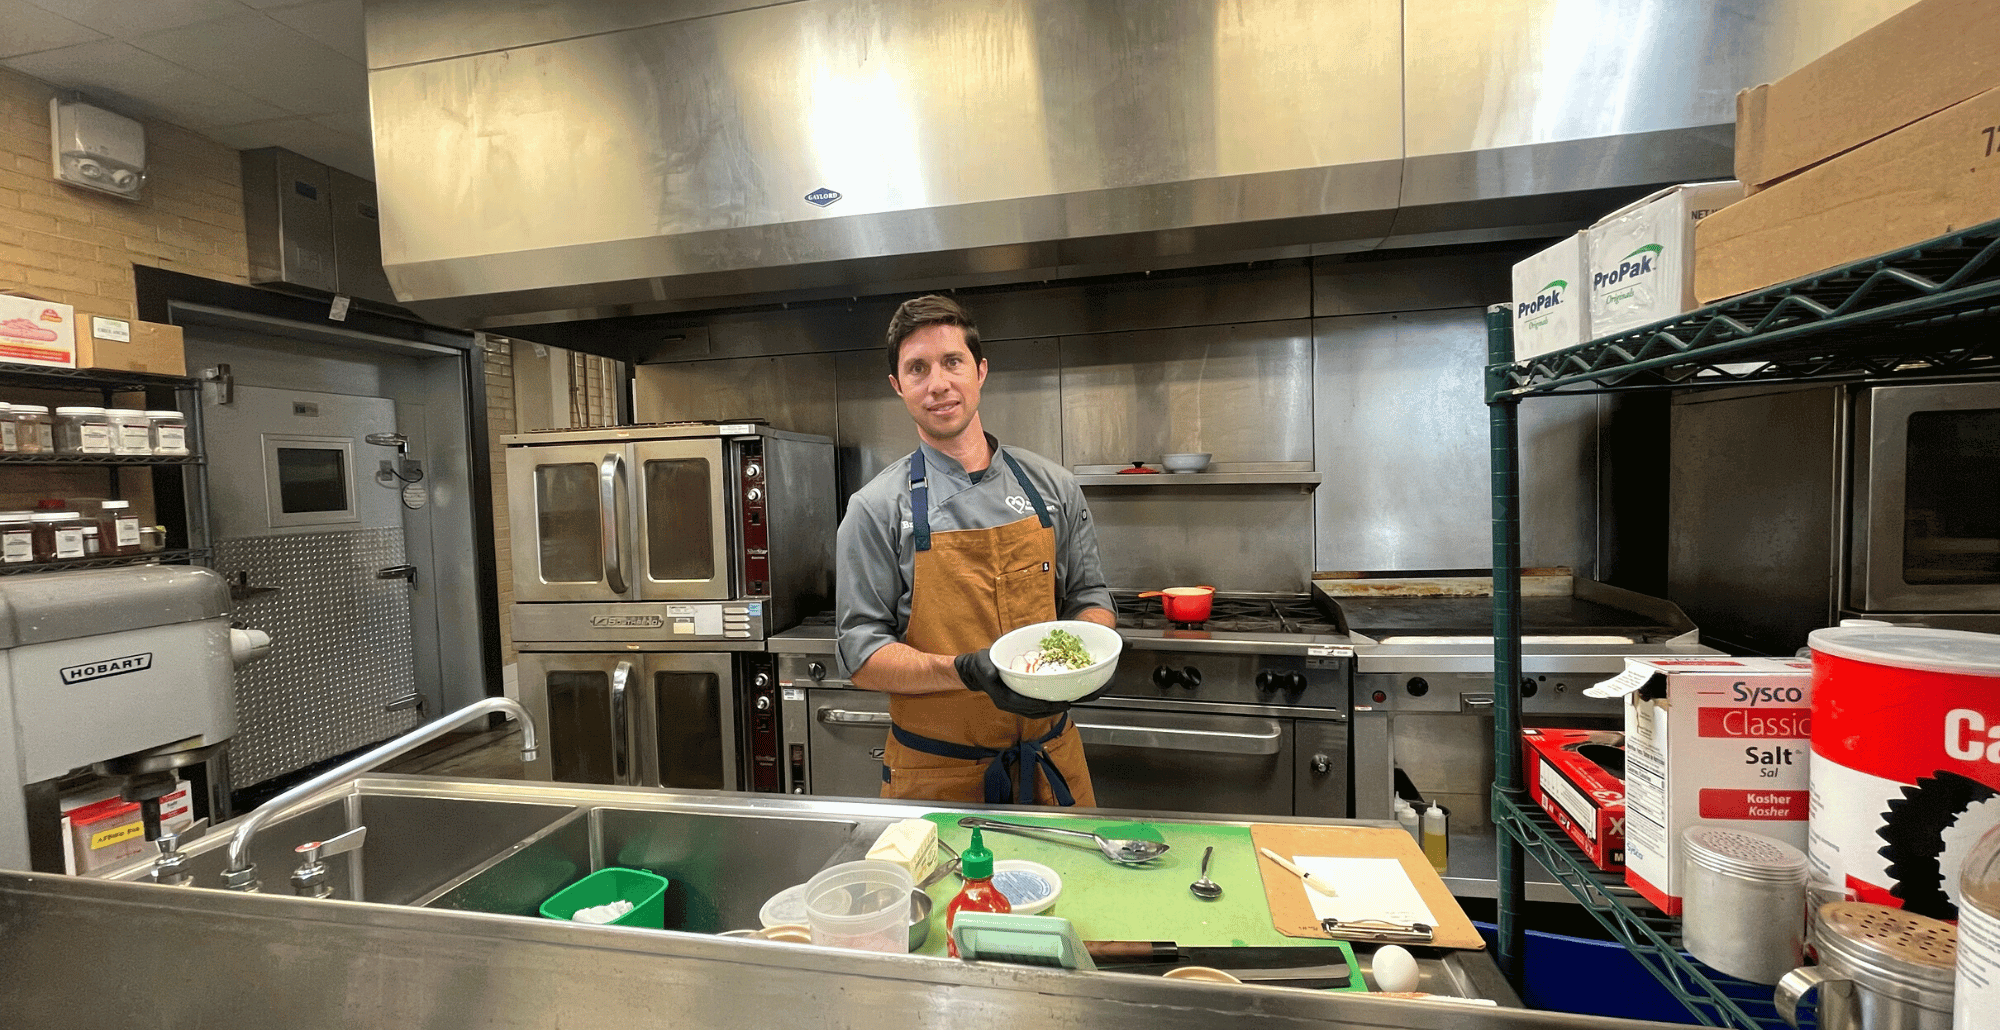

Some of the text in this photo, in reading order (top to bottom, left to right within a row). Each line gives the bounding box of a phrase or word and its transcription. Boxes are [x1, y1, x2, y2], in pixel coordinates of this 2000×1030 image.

[808, 192, 838, 200] GAYLORD
[1691, 209, 1709, 220] NET
[1593, 255, 1653, 291] ProPak
[1518, 290, 1561, 318] ProPak
[1606, 288, 1635, 305] Originals
[70, 657, 144, 679] HOBART
[1732, 681, 1802, 707] Sysco
[1722, 710, 1811, 736] Classic
[1745, 746, 1793, 765] Salt
[1759, 768, 1779, 778] Sal
[1747, 793, 1791, 805] Kosher
[1748, 806, 1790, 817] Kosher
